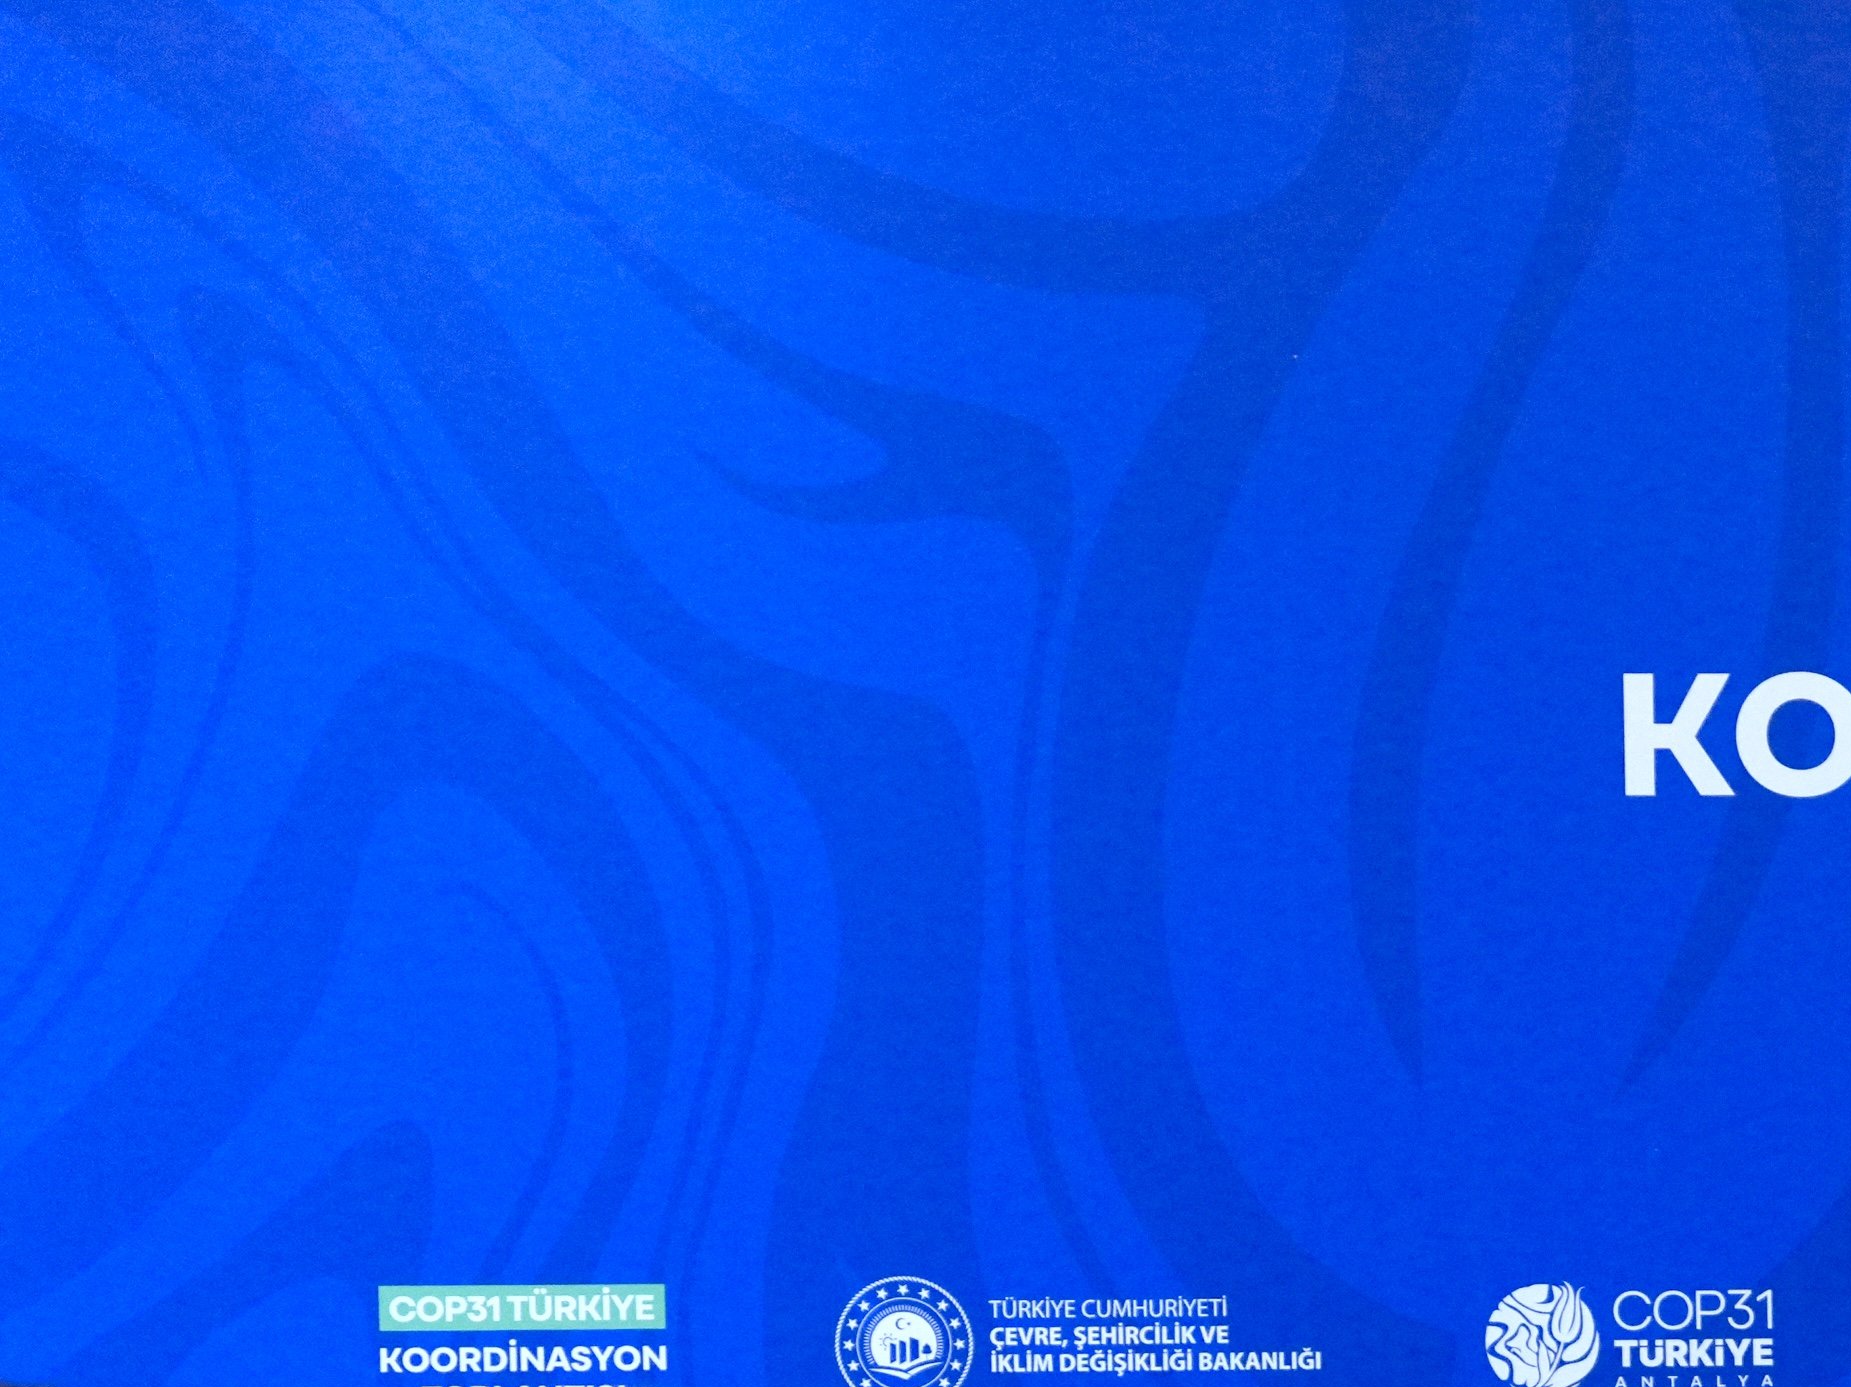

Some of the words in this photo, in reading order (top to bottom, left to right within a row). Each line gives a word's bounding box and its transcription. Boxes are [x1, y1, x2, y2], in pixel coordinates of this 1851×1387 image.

[388, 1295, 501, 1323] COP31
[506, 1286, 655, 1322] TÜRKİYE
[988, 1296, 1076, 1319] TÜRKİYE
[1081, 1295, 1228, 1319] CUMHURİYETİ
[1612, 1289, 1773, 1331] COP31
[989, 1326, 1068, 1350] ÇEVRE,
[1073, 1321, 1197, 1349] ŞEHİRCİLİK
[1199, 1325, 1230, 1344] VE
[379, 1338, 668, 1373] KOORDİNASYON
[990, 1348, 1054, 1373] İKLİM
[1059, 1347, 1193, 1377] DEĞİŞİKLİĞİ
[1198, 1347, 1322, 1371] BAKANLIĞI
[1613, 1337, 1774, 1368] TÜRKİYE
